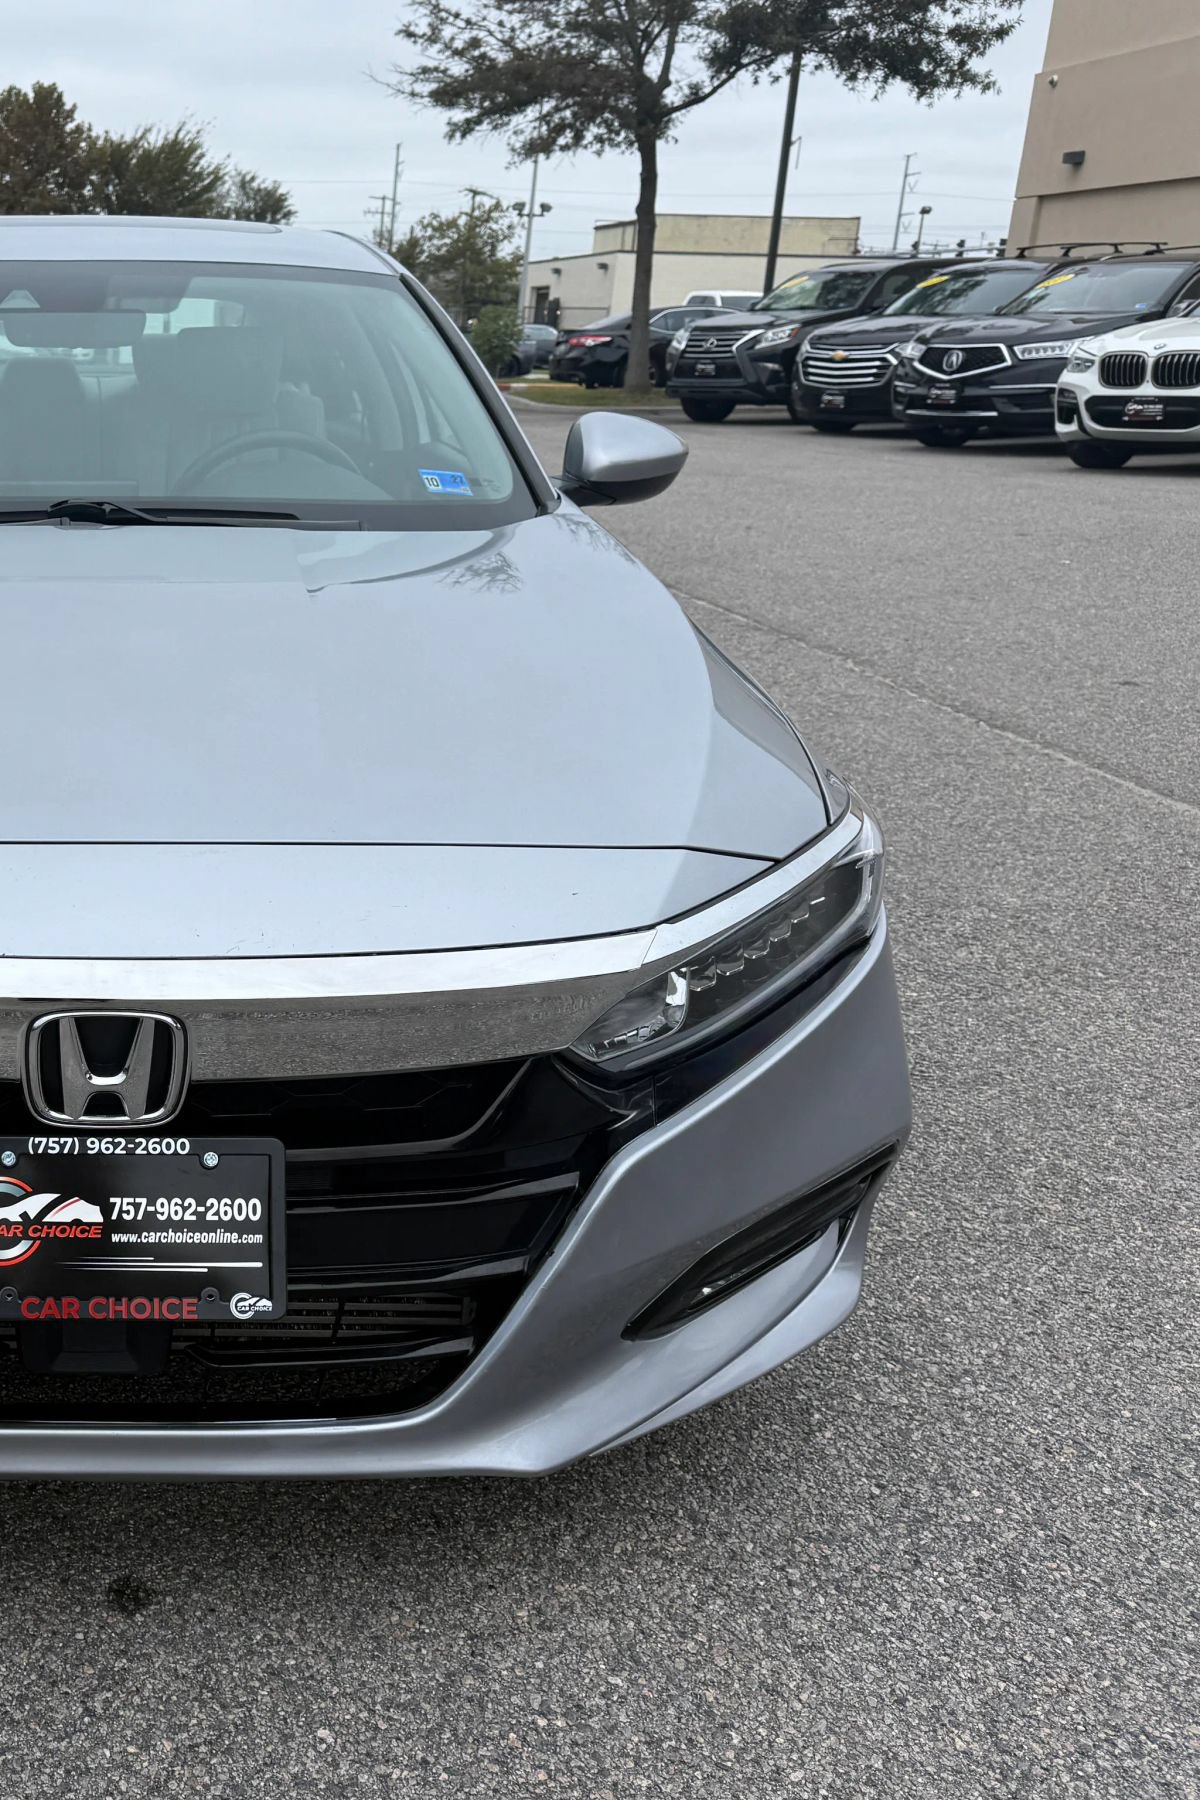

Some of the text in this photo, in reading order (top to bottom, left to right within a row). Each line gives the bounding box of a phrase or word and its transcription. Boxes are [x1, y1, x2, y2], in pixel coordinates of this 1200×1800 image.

[424, 476, 440, 488] 10
[28, 1136, 190, 1155] (757) 962-2600
[109, 1197, 262, 1221] 757-962-2600
[28, 1225, 103, 1238] CHOICE
[111, 1228, 263, 1244] www.carchoiceonline.com
[20, 1297, 199, 1320] CAR CHOICE
